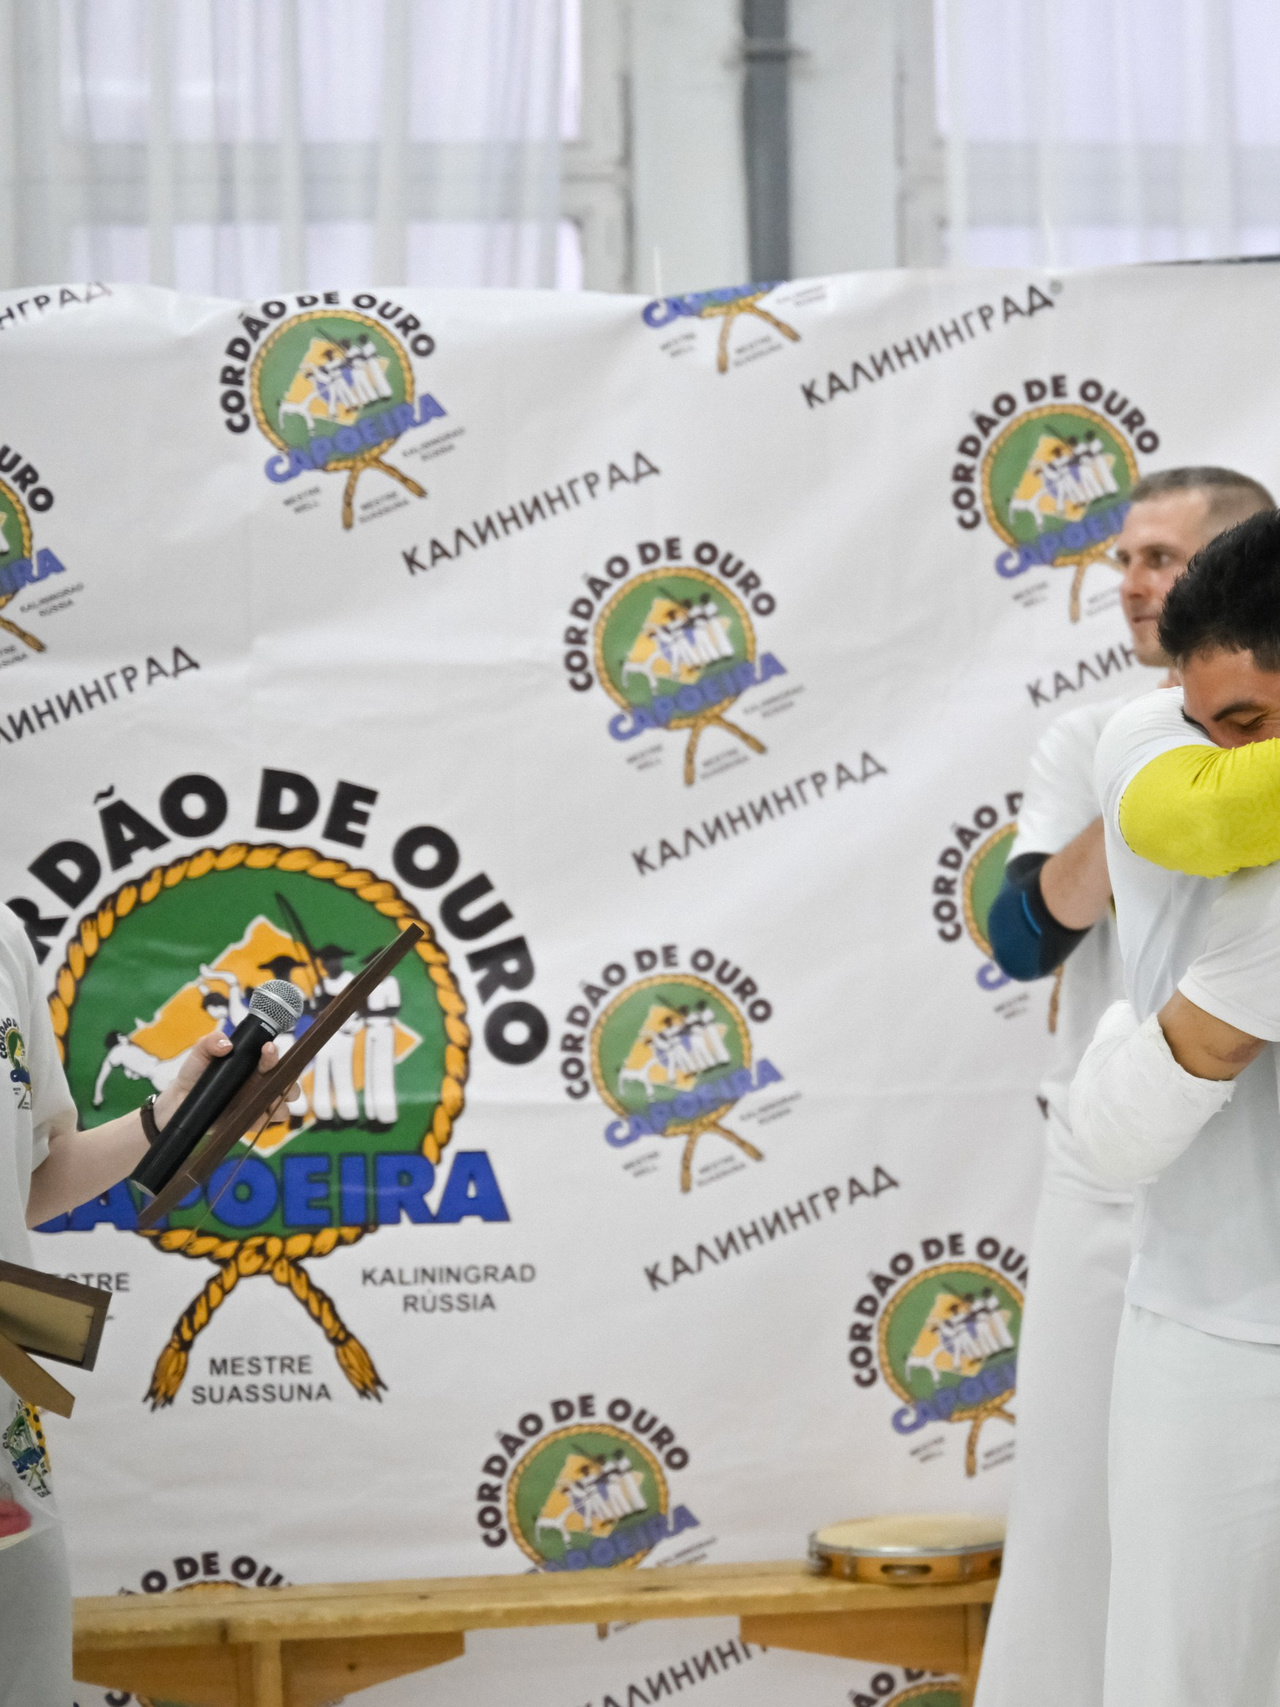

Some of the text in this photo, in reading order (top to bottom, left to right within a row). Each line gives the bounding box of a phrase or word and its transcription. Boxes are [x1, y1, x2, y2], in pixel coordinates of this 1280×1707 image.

[220, 292, 435, 434] CORDÃO DE OURO
[801, 284, 1054, 409] КАЛИНИНГРАД
[264, 393, 447, 483] CAPOEIRA
[1023, 375, 1068, 403] DE
[1078, 379, 1160, 454] OURO
[0, 445, 54, 512] URO
[402, 451, 661, 576] КАЛИНИНГРАД
[637, 537, 682, 566] DE
[694, 541, 776, 617] OURO
[631, 751, 888, 876] КАЛИНИНГРАД
[5, 767, 549, 1066] RDÃO DE OURO
[634, 945, 679, 972] DE
[690, 948, 773, 1024] OURO
[643, 1164, 900, 1292] КАЛИНИНГРАД
[921, 1233, 965, 1262] DE
[976, 1237, 1028, 1288] OU
[361, 1263, 537, 1287] KALININGRAD
[192, 1383, 332, 1405] SUASSUNA
[209, 1355, 313, 1376] MESTRE
[551, 1394, 596, 1423] DE
[607, 1399, 689, 1471] OURO
[173, 1552, 220, 1581] DE
